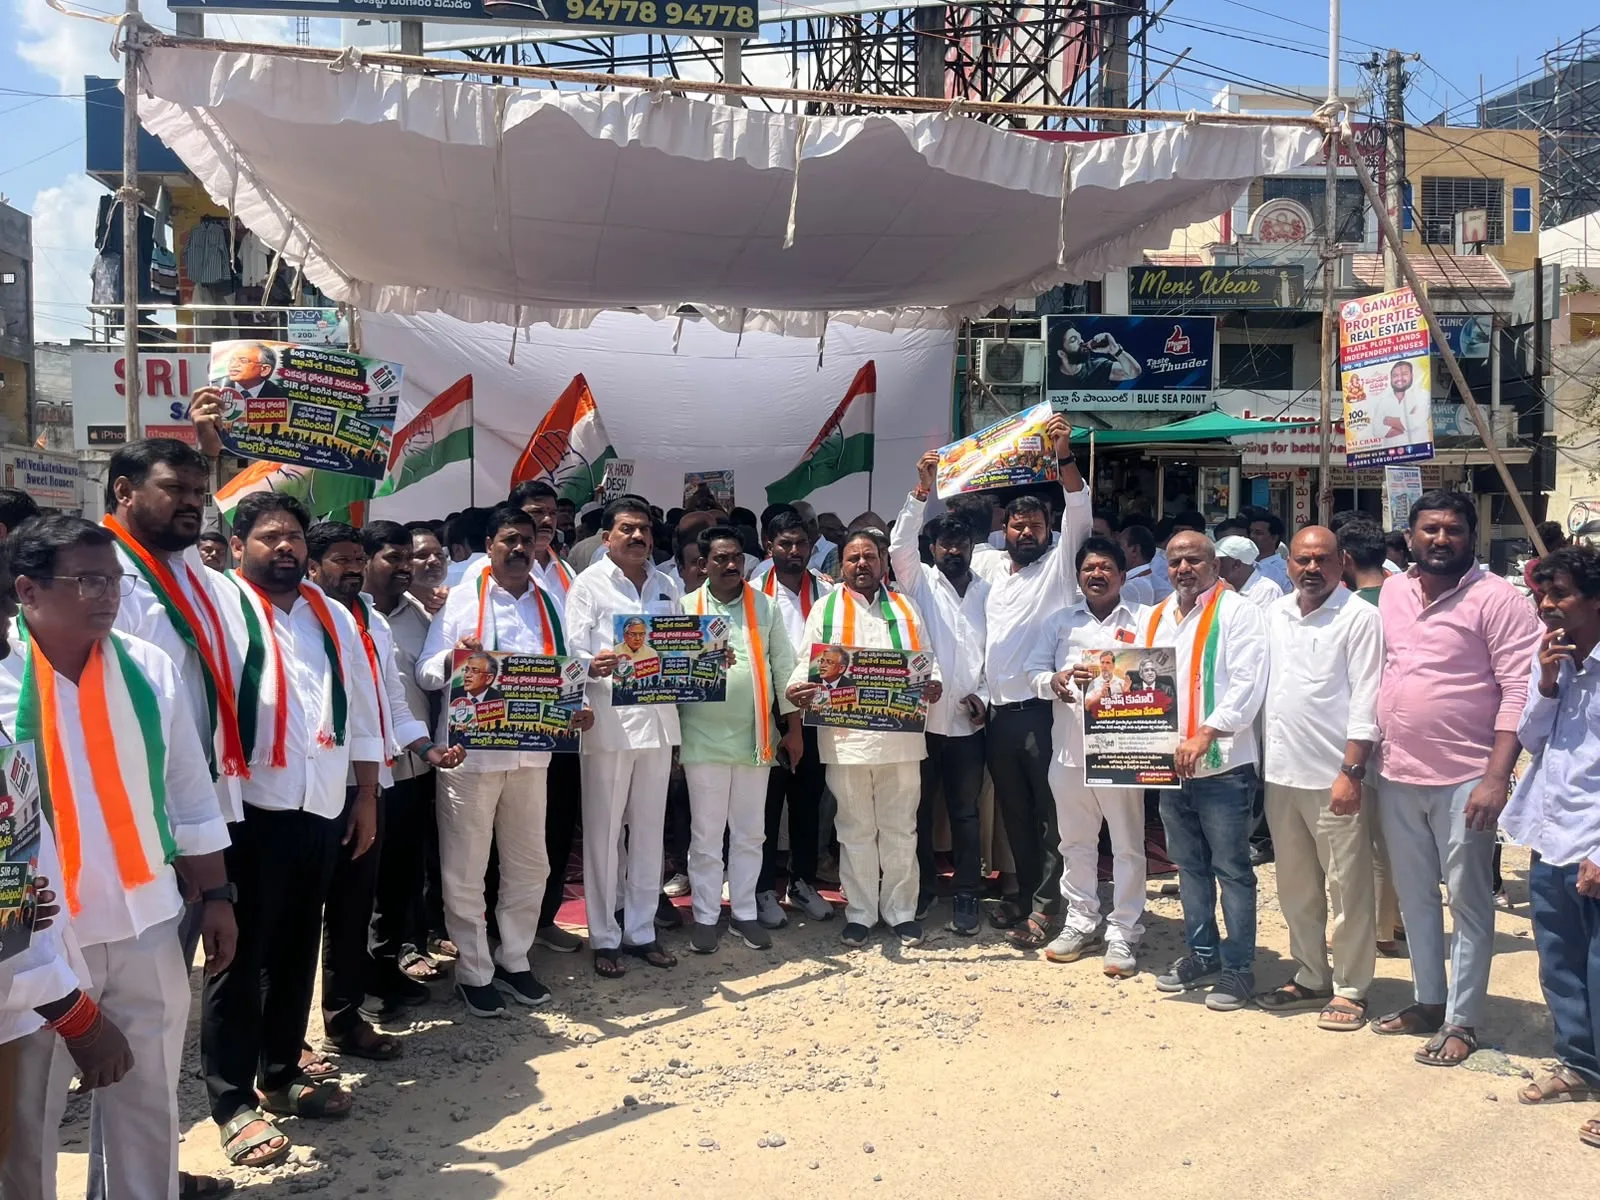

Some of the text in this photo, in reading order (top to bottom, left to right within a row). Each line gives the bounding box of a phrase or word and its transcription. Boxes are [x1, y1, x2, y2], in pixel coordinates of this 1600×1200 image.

[566, 0, 754, 28] 94778 94778
[1199, 270, 1261, 295] Wear
[1345, 307, 1422, 333] PROPERTIES
[1350, 320, 1417, 343] REAL ESTATE
[1396, 332, 1421, 343] LANDS
[1344, 346, 1392, 362] INDEPENDENT
[1393, 340, 1424, 352] HOUSES
[1147, 358, 1170, 367] Taste
[1158, 358, 1209, 372] Thunder
[283, 380, 299, 390] SIR
[1083, 392, 1129, 404] పాయింట్
[1137, 393, 1207, 404] BLUE SEA POINT
[349, 419, 361, 429] SIR
[1271, 441, 1288, 453] for
[1291, 442, 1320, 454] bette
[606, 477, 627, 492] DESH
[501, 684, 513, 692] SIR
